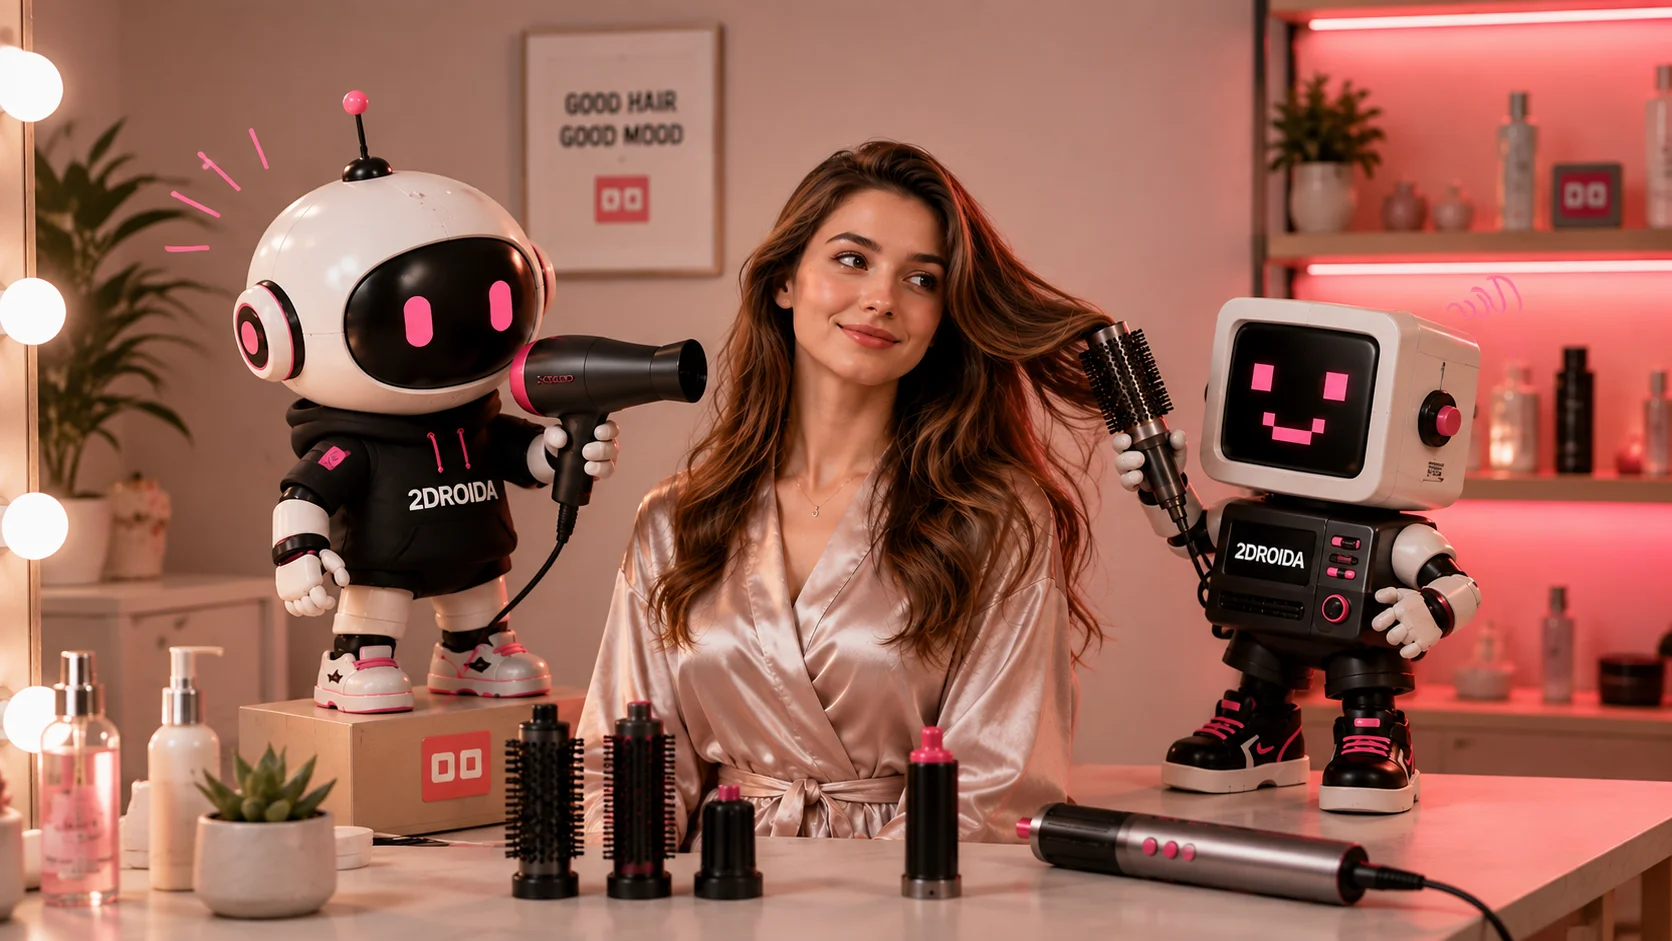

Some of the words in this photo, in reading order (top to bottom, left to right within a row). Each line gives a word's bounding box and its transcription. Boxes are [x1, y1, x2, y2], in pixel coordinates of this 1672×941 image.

[565, 92, 621, 115] GOOD
[627, 90, 677, 113] HAIR
[559, 125, 617, 147] GOOD
[623, 124, 684, 145] MOOD
[408, 480, 498, 511] 2DROIDA
[1234, 542, 1305, 569] 2DROIDA
